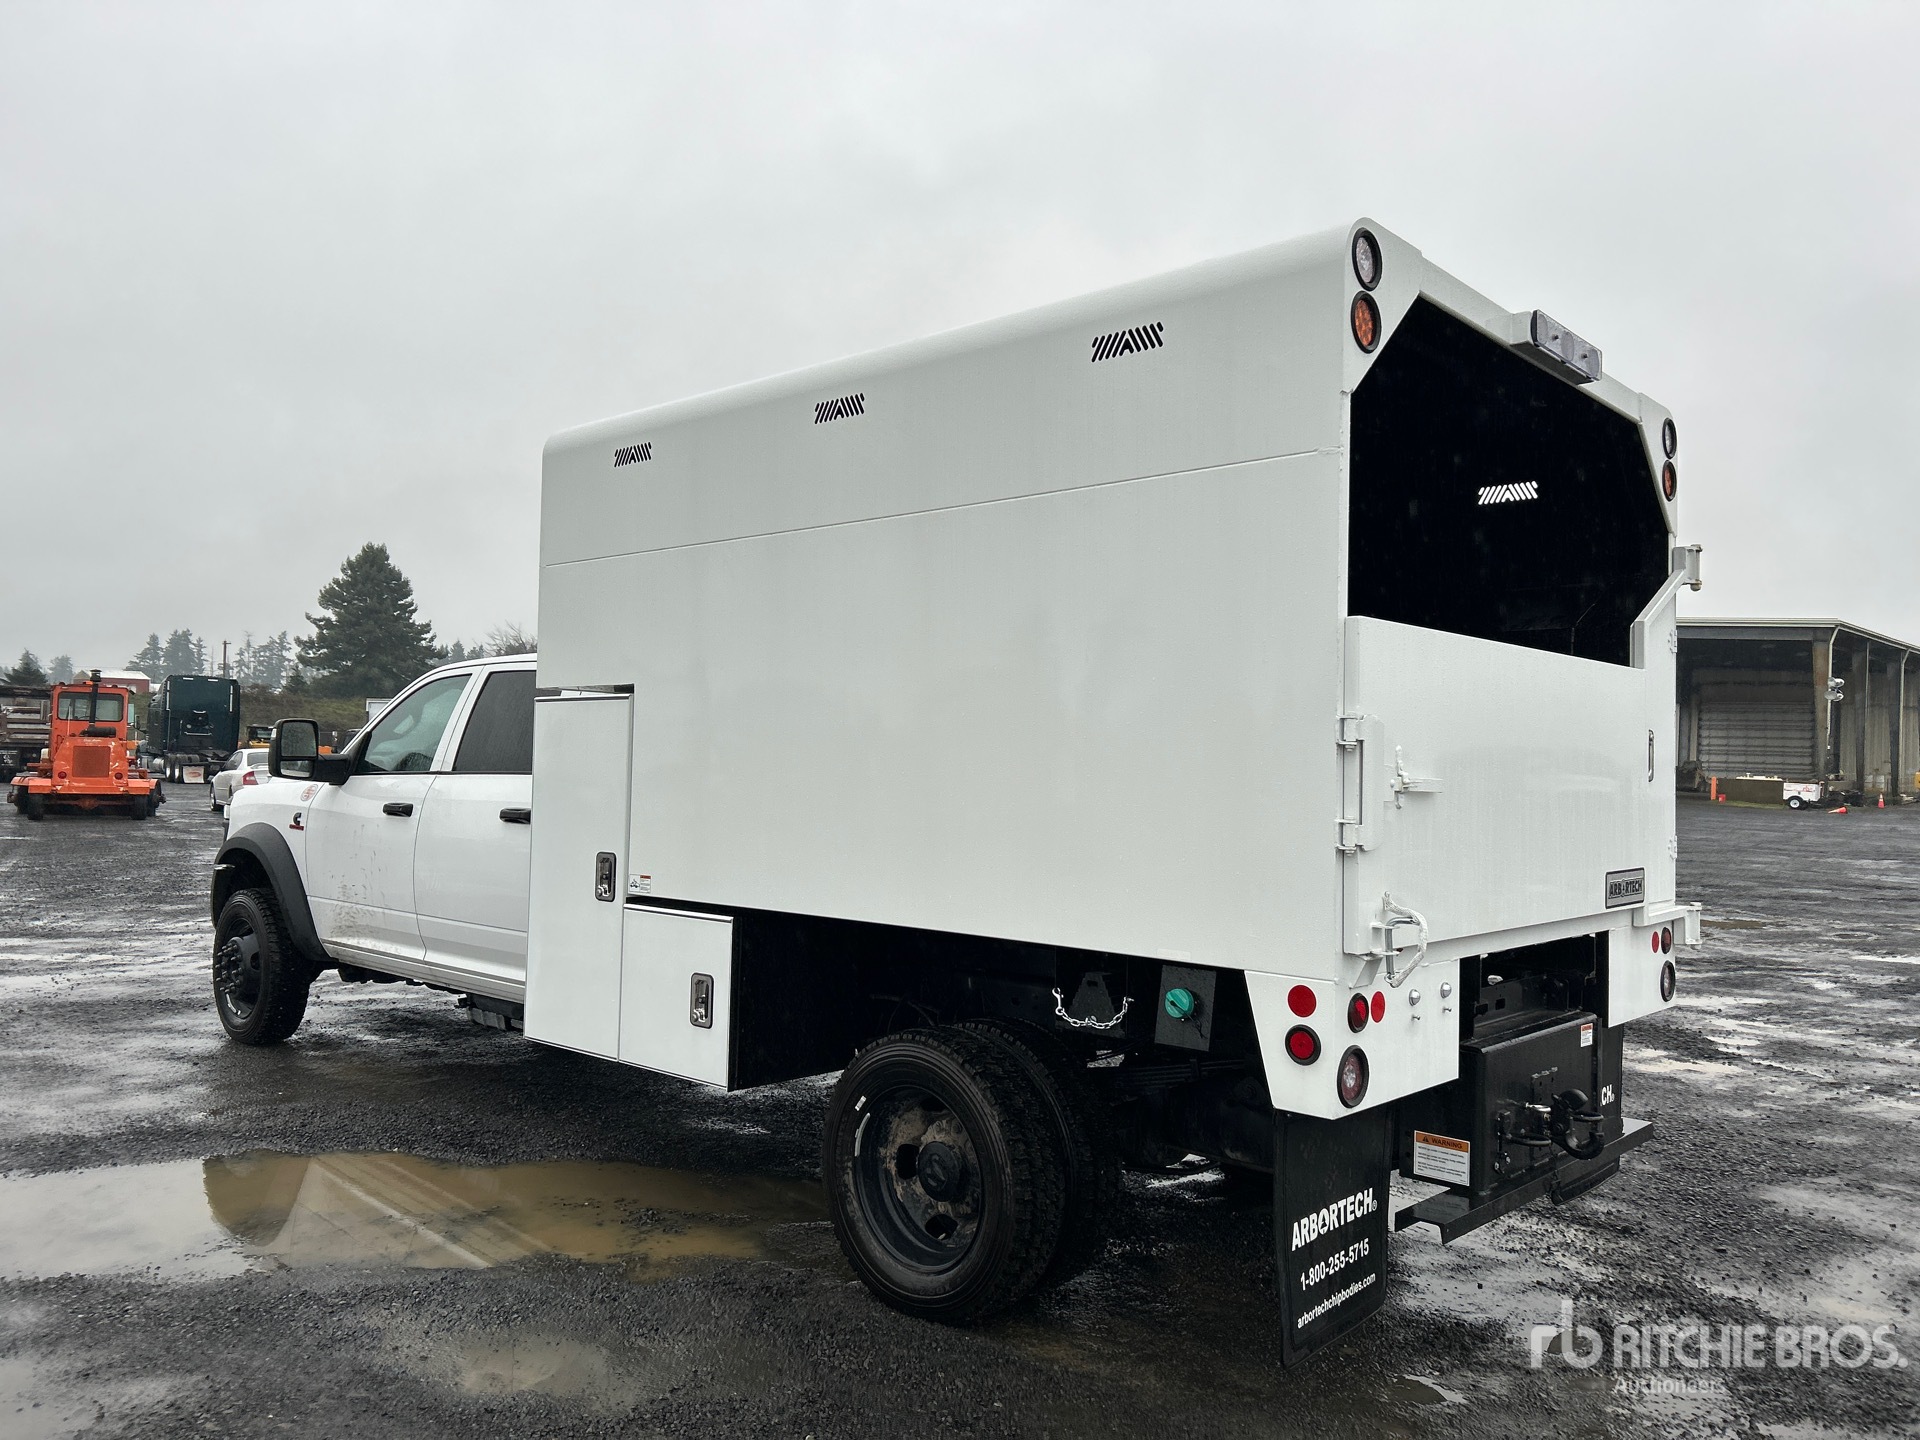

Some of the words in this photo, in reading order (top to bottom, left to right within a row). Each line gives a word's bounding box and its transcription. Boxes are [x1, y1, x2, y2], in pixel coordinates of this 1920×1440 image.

[1431, 1137, 1463, 1149] WARNING
[1300, 1238, 1370, 1291] 1-800-255-5715
[1297, 1273, 1376, 1329] arbortechchipbodies.com
